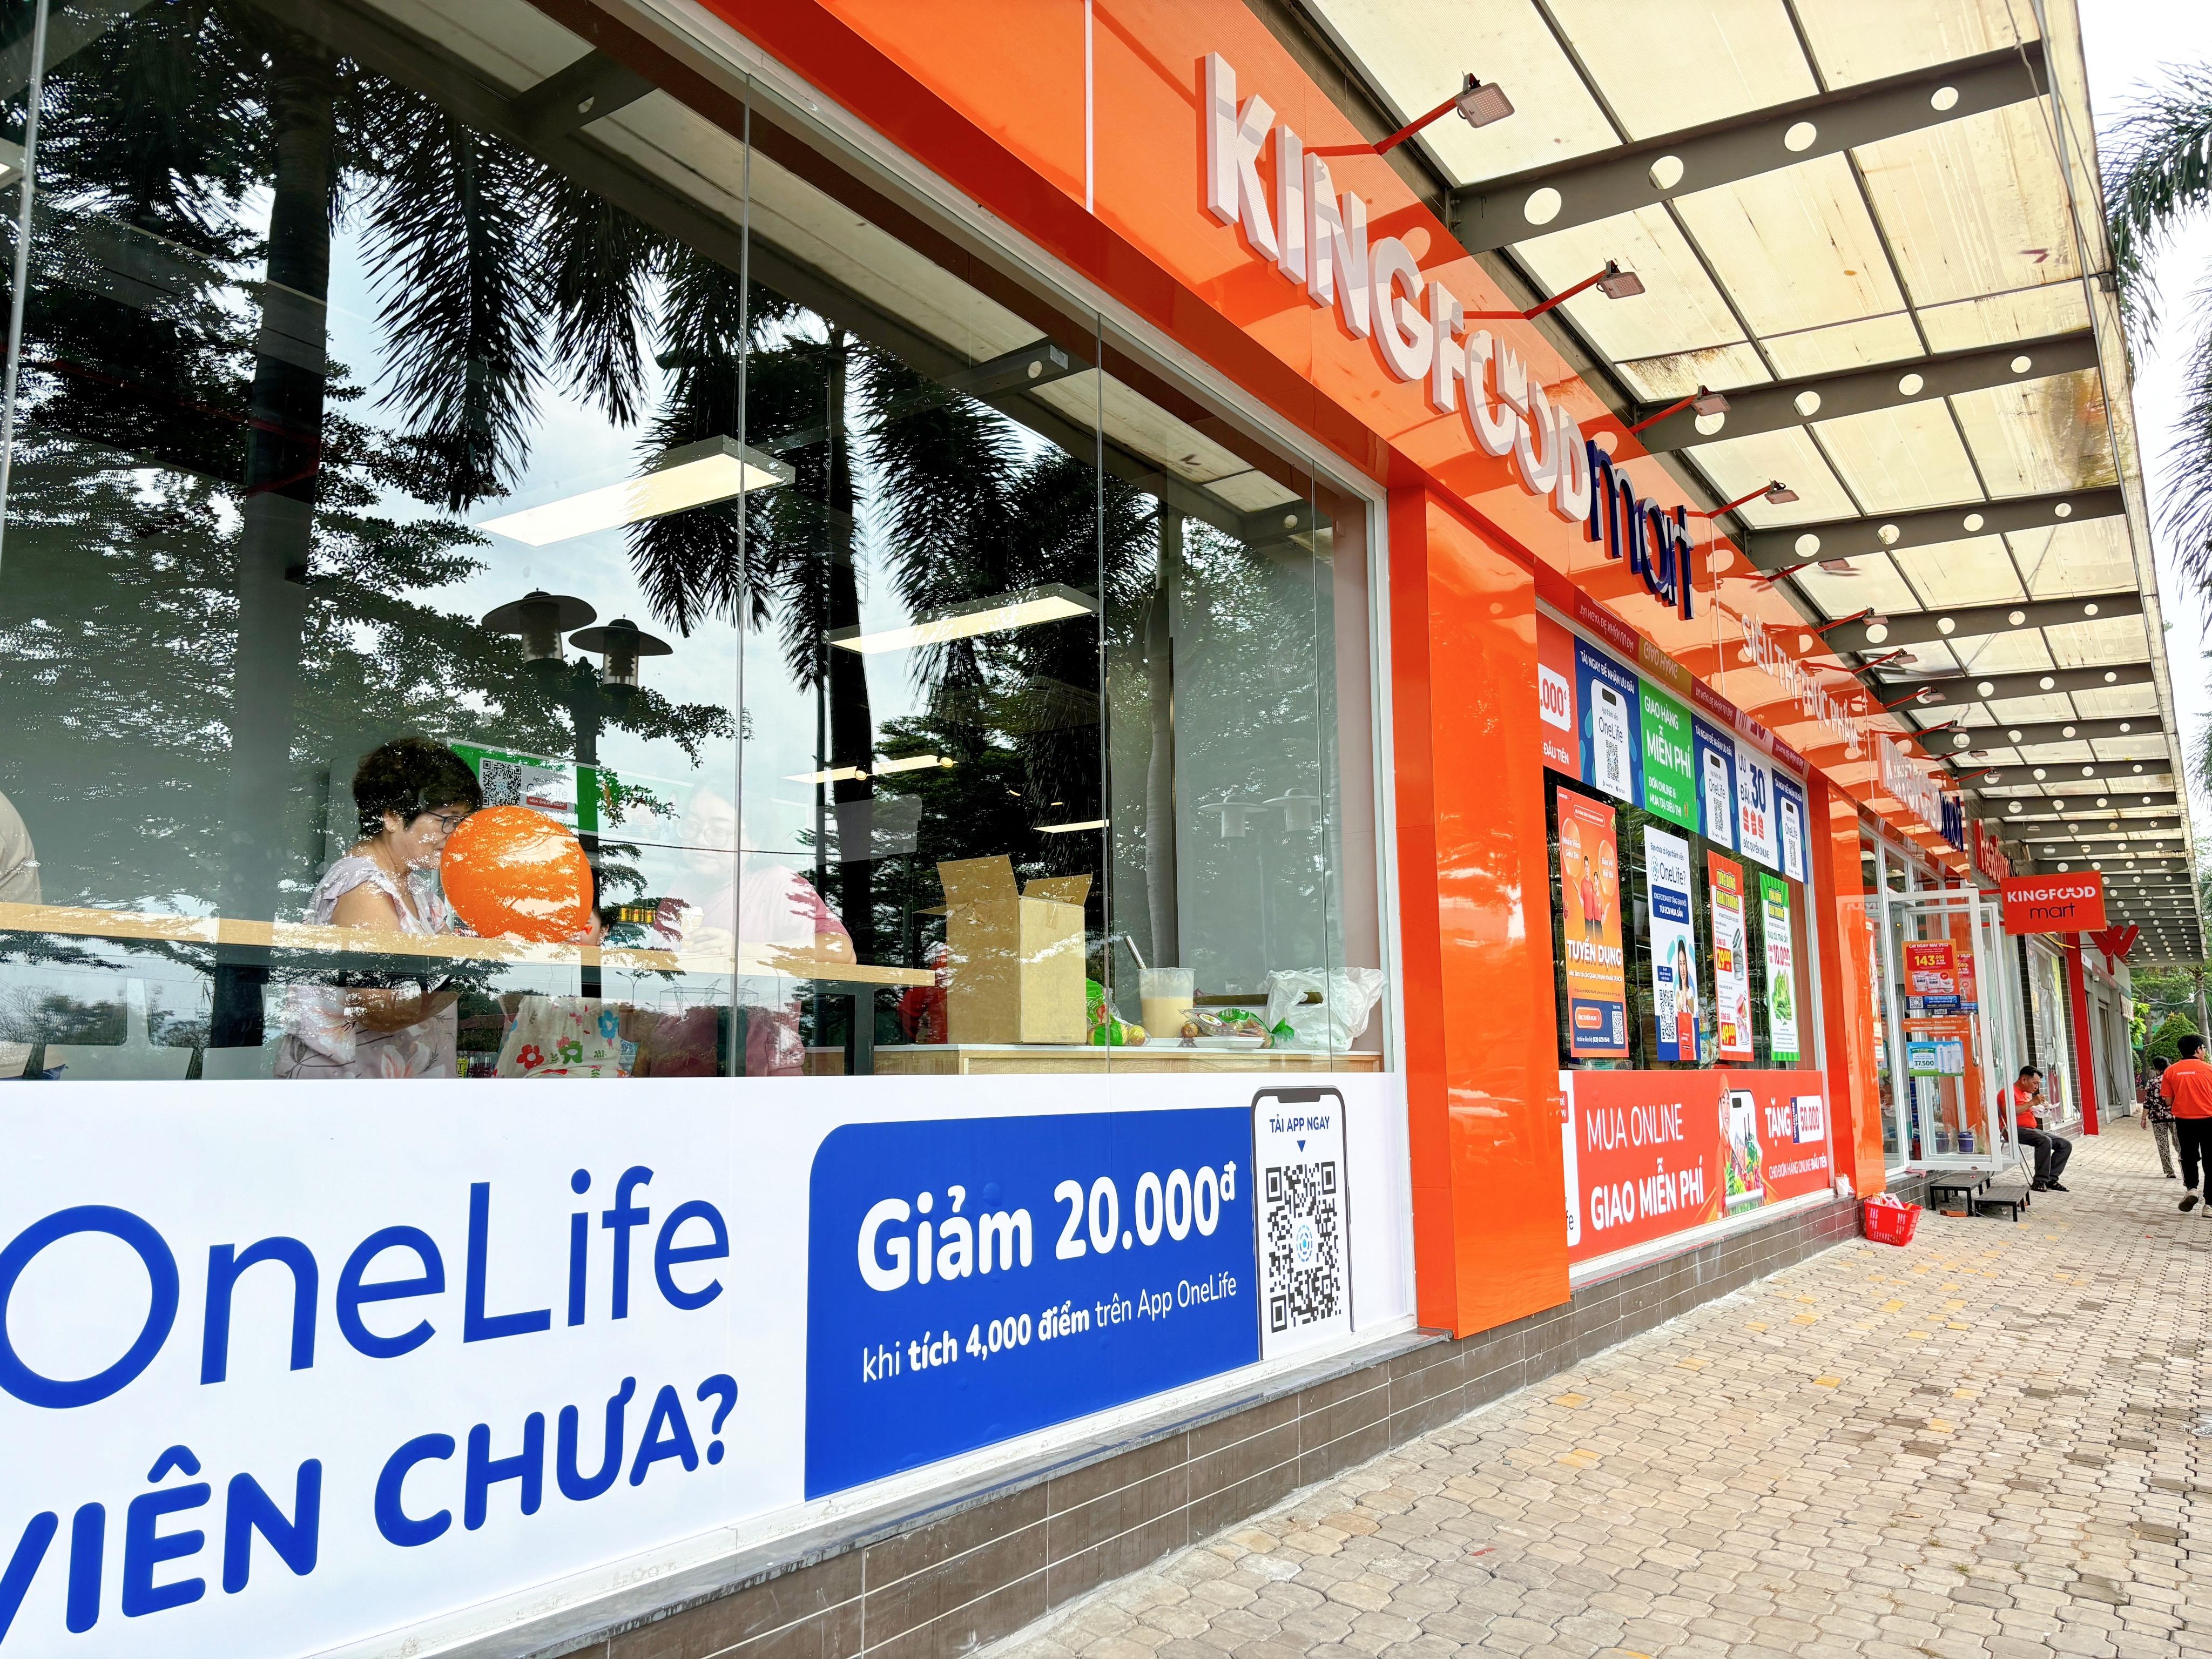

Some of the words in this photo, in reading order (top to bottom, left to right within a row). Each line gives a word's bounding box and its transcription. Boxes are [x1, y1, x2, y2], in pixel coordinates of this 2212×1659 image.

[1205, 51, 1590, 522] KINGFOOD
[1586, 439, 1695, 619] mart
[1588, 656, 1601, 672] NGAY
[1742, 613, 1773, 676] SIÊU
[1774, 643, 1798, 710] THỊ
[1599, 717, 1623, 743] OneLife
[1644, 695, 1660, 718] GIAO
[1661, 704, 1678, 730] HÀNG
[1556, 747, 1569, 765] TIÊN
[1647, 725, 1673, 770] MIỄN
[1674, 745, 1691, 779] PHÍ
[527, 783, 568, 799] OeLife
[1649, 792, 1660, 807] MUA
[1658, 780, 1673, 798] ONLINE
[1709, 778, 1725, 799] OneLife
[1660, 862, 1686, 886] OneLife?
[2007, 886, 2096, 902] KINGFOOD
[2030, 902, 2075, 919] mart
[1567, 935, 1597, 964] TUYỂN
[1598, 945, 1622, 970] DỤNG
[1269, 1114, 1284, 1134] TẢI
[1287, 1117, 1305, 1132] APP
[1307, 1116, 1330, 1131] NGAY
[1586, 1107, 1628, 1152] MUA
[1631, 1103, 1684, 1147] ONLINE
[1764, 1097, 1791, 1147] TẶNG
[1769, 1165, 1778, 1179] CHO
[1787, 1158, 1798, 1176] HÀNG
[1798, 1158, 1811, 1173] ONLINE
[1590, 1179, 1635, 1231] GIAO
[1638, 1156, 1677, 1219] MIỄN
[1680, 1154, 1704, 1208] PHÍ
[857, 1185, 1033, 1292] Giảm
[1054, 1159, 1237, 1261] 20.000đ
[0, 1165, 730, 1409] OneLife
[863, 1341, 900, 1384] khi
[908, 1327, 957, 1372] tích
[965, 1312, 1029, 1361] 4,000
[1038, 1299, 1090, 1341] điểm
[1095, 1294, 1131, 1328] trên
[1137, 1288, 1172, 1323] App
[1176, 1270, 1237, 1308] OneLife
[375, 1374, 738, 1547] CHƯA?
